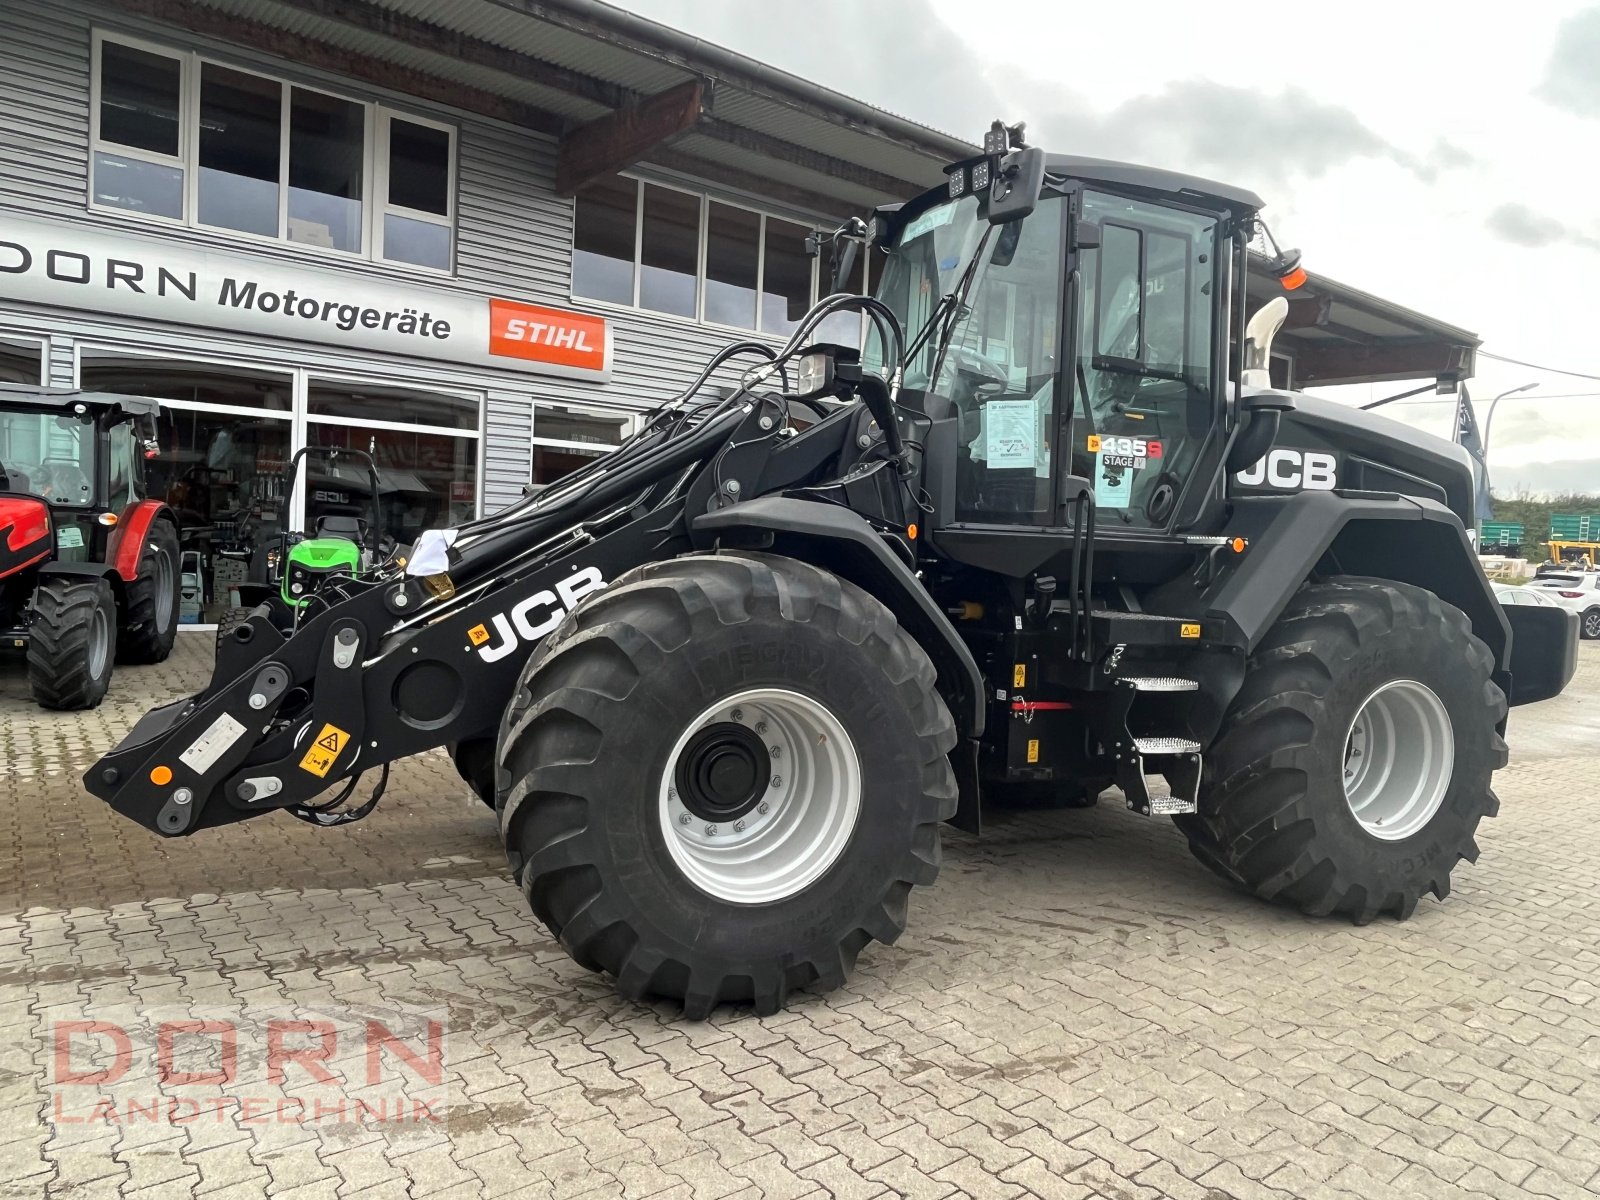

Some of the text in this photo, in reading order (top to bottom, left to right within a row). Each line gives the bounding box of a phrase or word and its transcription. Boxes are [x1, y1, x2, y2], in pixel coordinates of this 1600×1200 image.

[0, 241, 451, 340] DORN Motorgeräte
[504, 318, 593, 352] STIHL
[1104, 455, 1133, 467] STAGE
[1237, 449, 1336, 490] JCB
[478, 566, 609, 663] JCB
